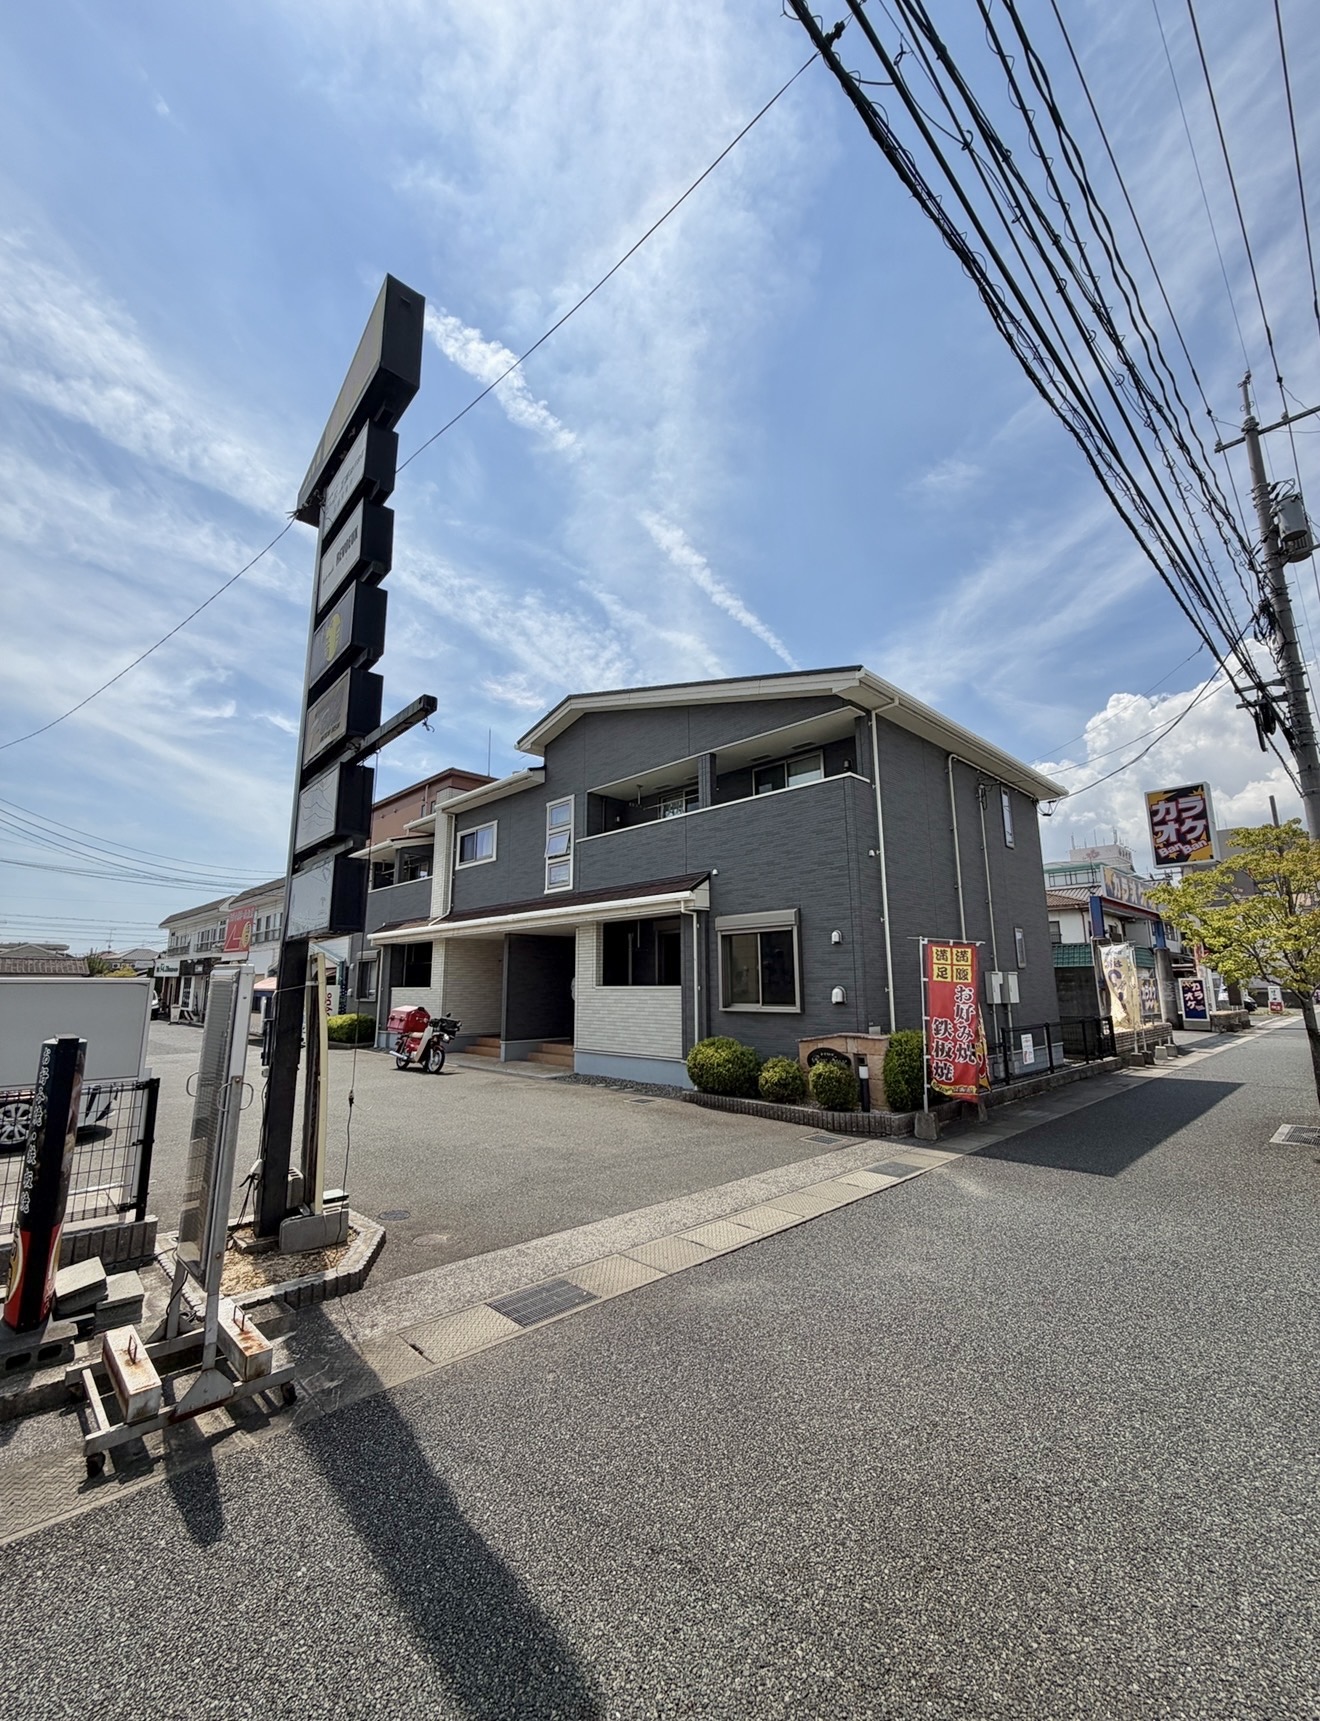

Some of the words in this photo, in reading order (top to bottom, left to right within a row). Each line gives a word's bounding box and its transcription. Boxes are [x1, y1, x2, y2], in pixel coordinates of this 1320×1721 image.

[1151, 796, 1204, 822] カラ
[1154, 819, 1206, 843] オケ
[934, 948, 949, 980] 満足
[954, 984, 977, 1065] お好み焼
[932, 1017, 954, 1082] 鉄板焼
